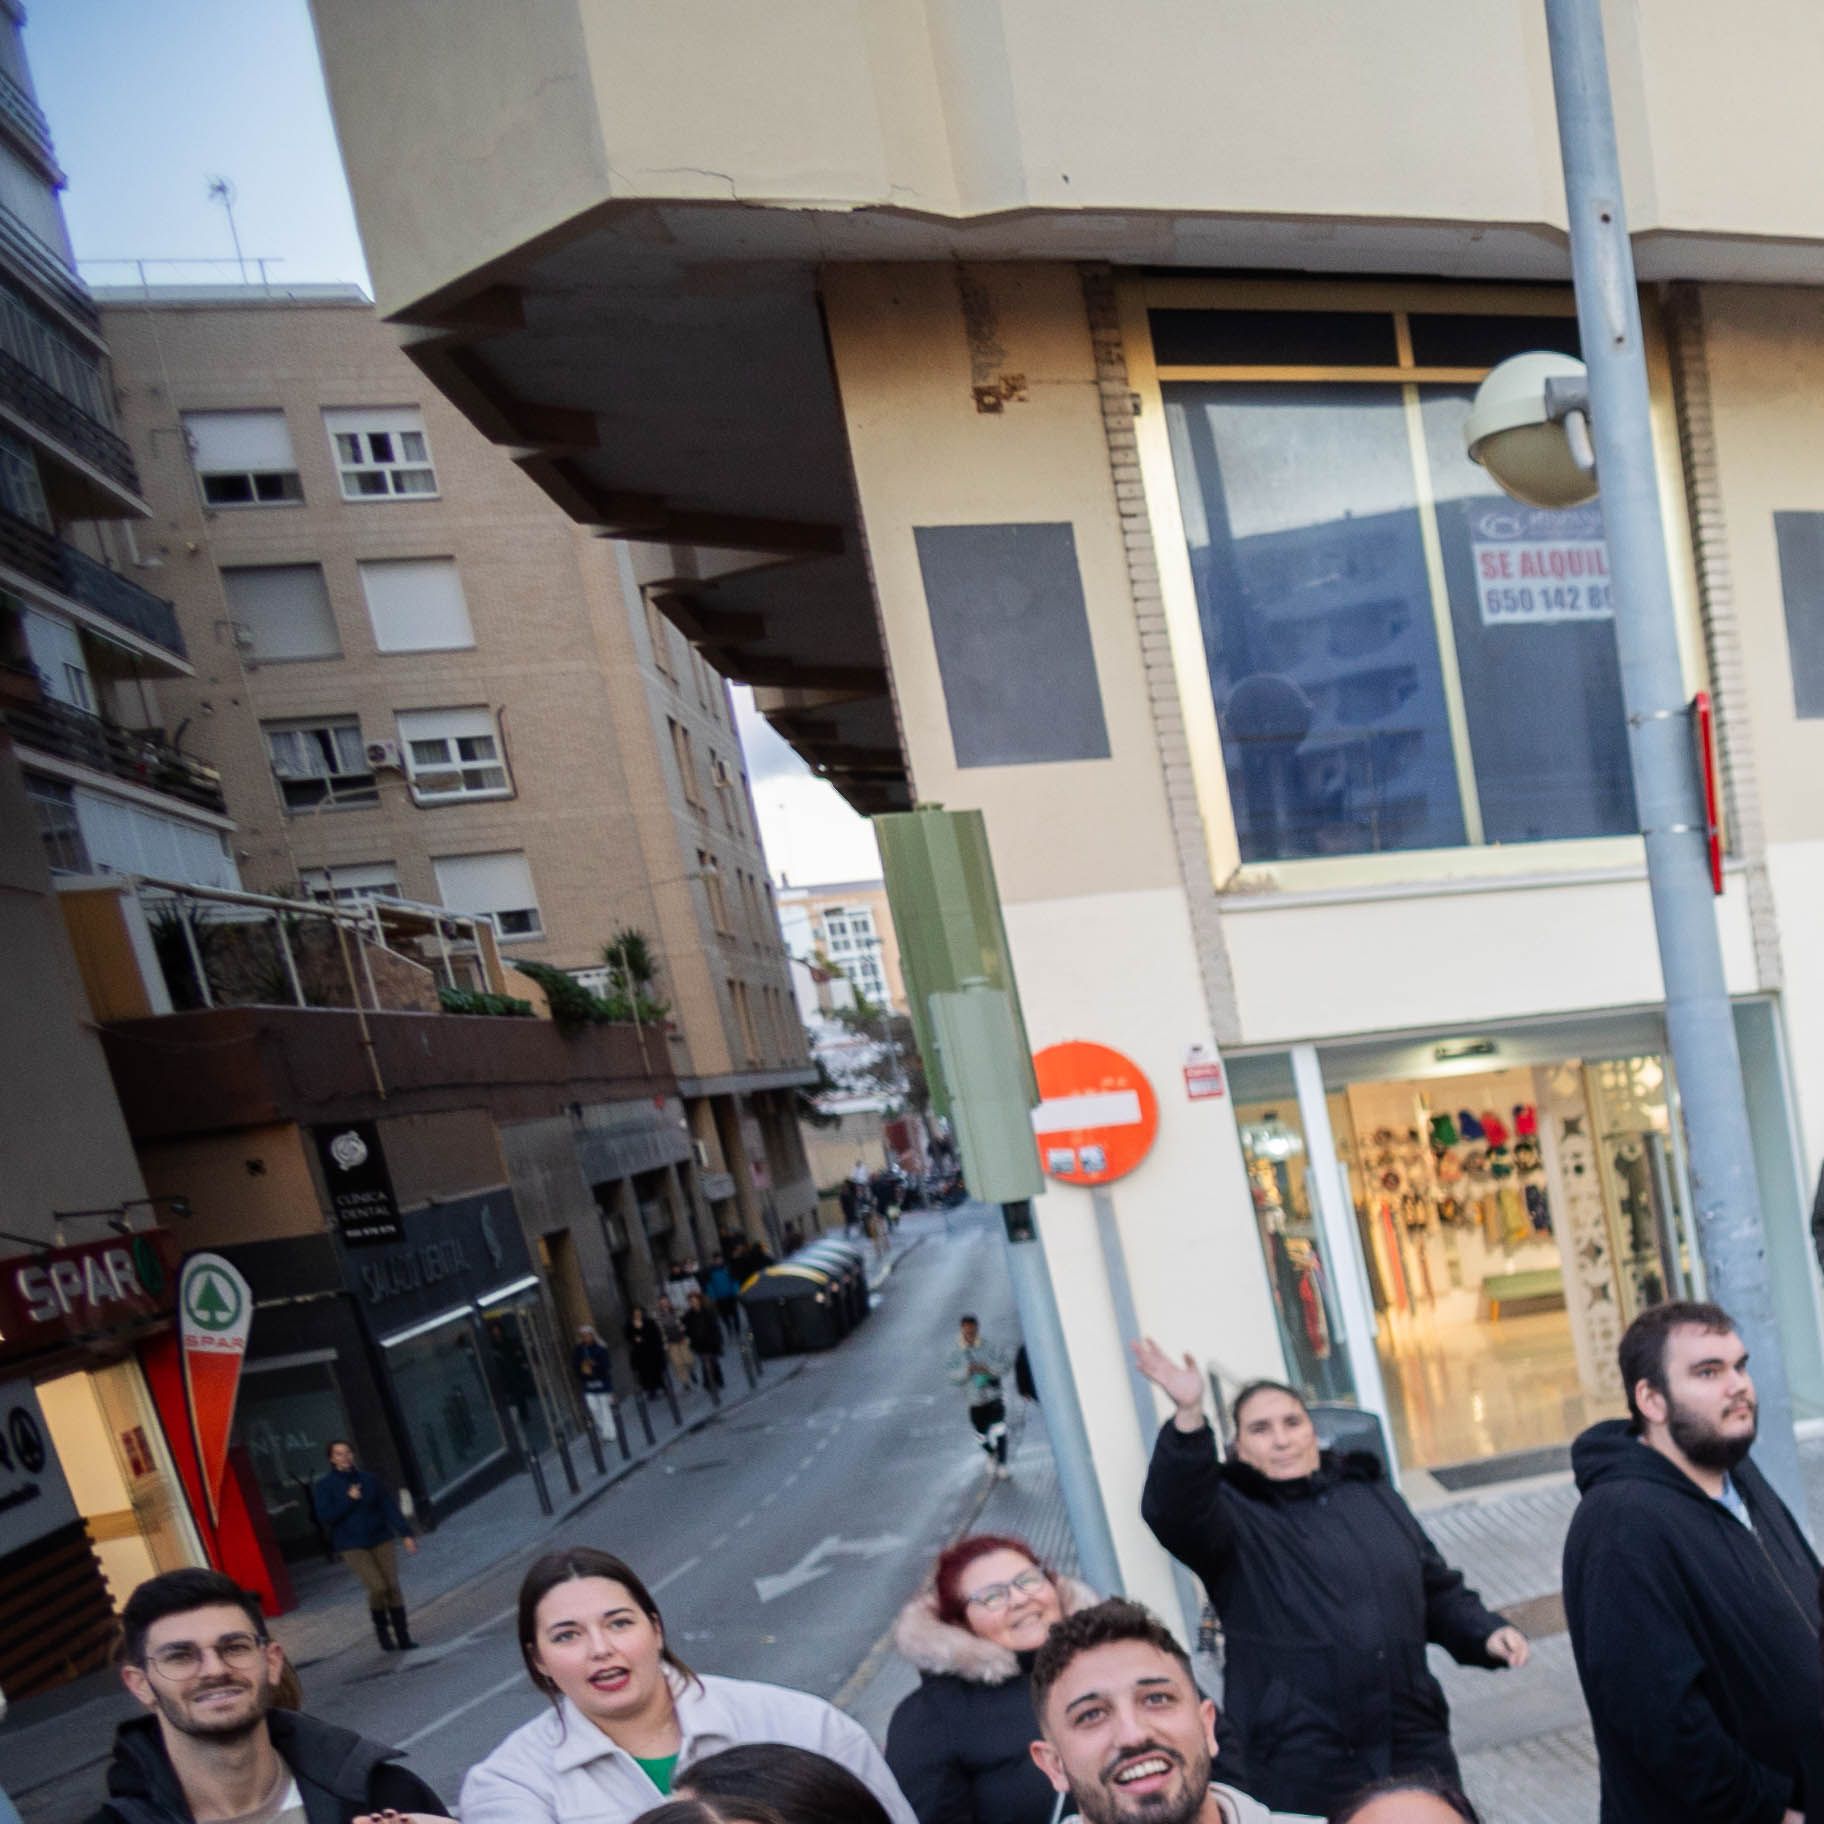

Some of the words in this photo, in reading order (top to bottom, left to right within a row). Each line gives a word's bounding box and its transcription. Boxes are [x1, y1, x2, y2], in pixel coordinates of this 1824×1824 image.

[1479, 551, 1511, 580] SE
[1519, 548, 1609, 582] ALQUIL
[16, 1248, 143, 1323] SPAR
[183, 1334, 245, 1349] SPAR
